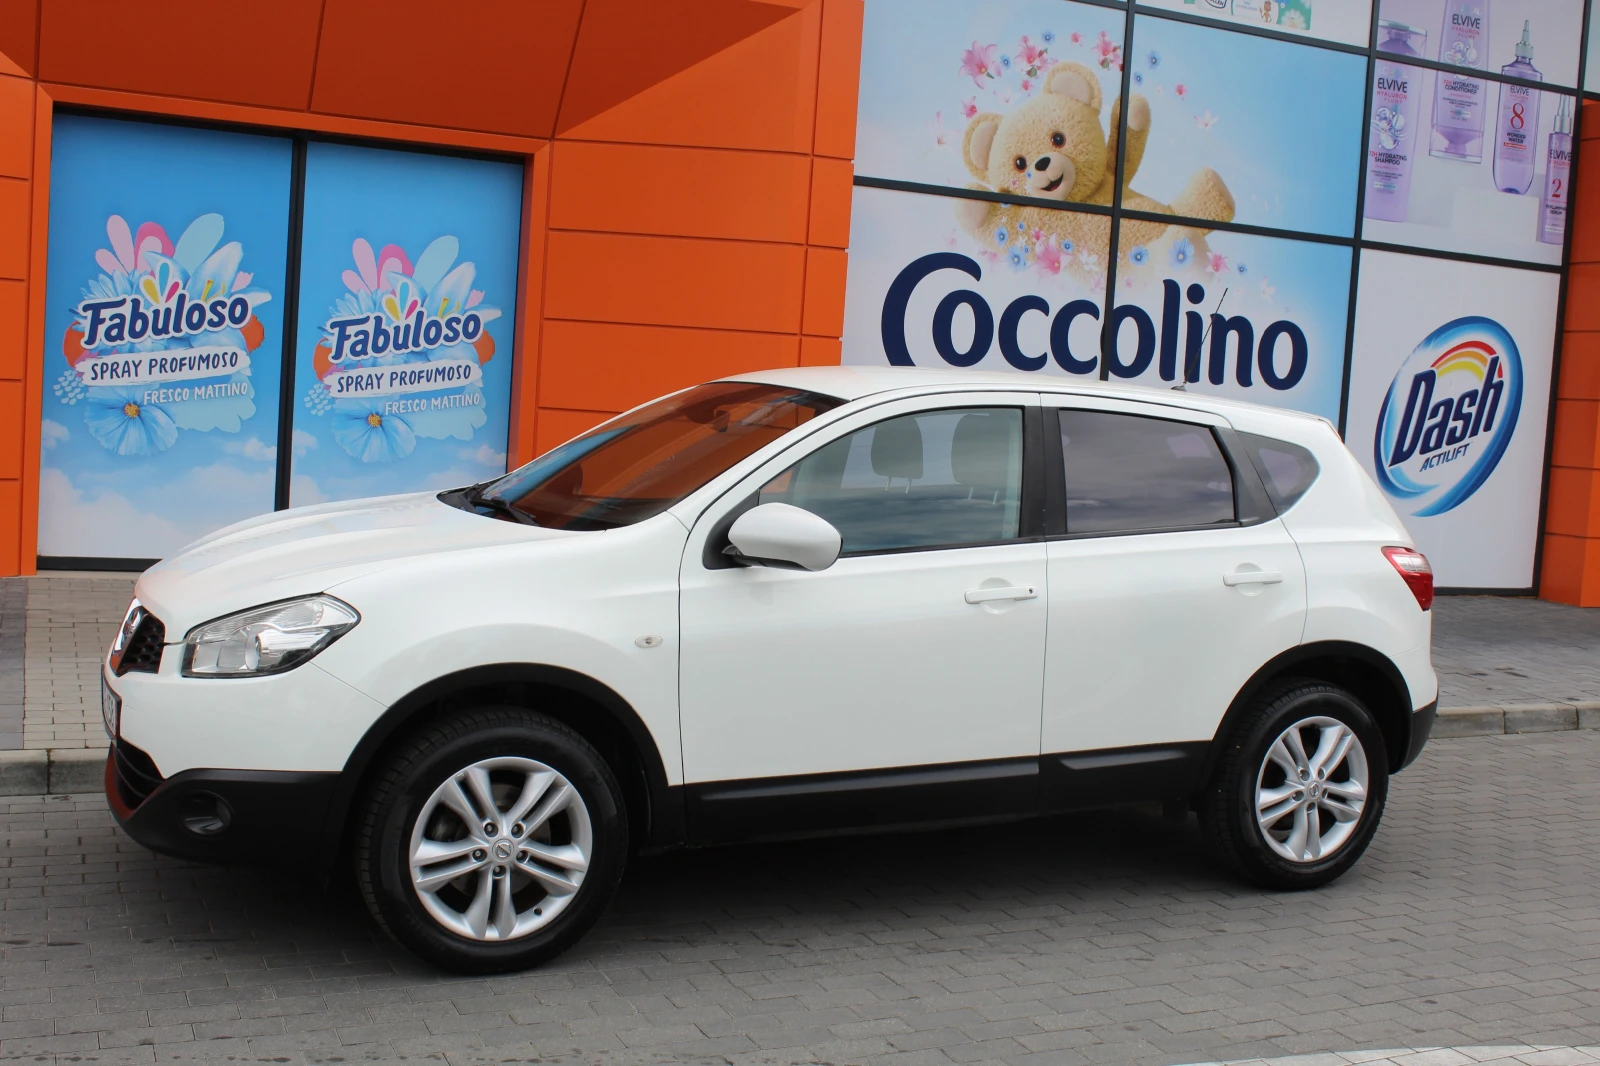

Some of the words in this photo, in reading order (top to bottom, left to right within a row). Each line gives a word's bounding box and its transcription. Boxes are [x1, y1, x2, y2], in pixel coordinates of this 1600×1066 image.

[1452, 13, 1481, 29] ELVIVE
[1377, 77, 1408, 93] ELVIVE
[1445, 85, 1478, 94] CONDITIONER
[1452, 80, 1480, 90] HYDRATING
[1510, 85, 1530, 96] ELVIVE
[1377, 90, 1408, 100] HYALURON
[1510, 102, 1525, 130] 8
[1506, 131, 1527, 140] WONDER
[1508, 136, 1524, 144] WATER
[1375, 156, 1401, 166] SHAMPOO
[1378, 152, 1408, 161] HYDRATING
[1549, 149, 1571, 162] ELVIVE
[1552, 178, 1562, 198] 2
[82, 293, 249, 346] Fabuloso
[881, 252, 1309, 391] Coccolino
[329, 310, 482, 361] Fabuloso
[91, 359, 143, 381] SPRAY
[149, 351, 239, 376] PROFUMOSO
[337, 372, 384, 393] SPRAY
[389, 364, 472, 388] PROFUMOSO
[143, 387, 190, 405] FRESCO
[194, 382, 248, 401] MATTINO
[385, 398, 427, 416] FRESCO
[431, 392, 480, 411] MATTINO
[1388, 355, 1505, 467] Dash
[1419, 442, 1471, 473] ACTILIFT
